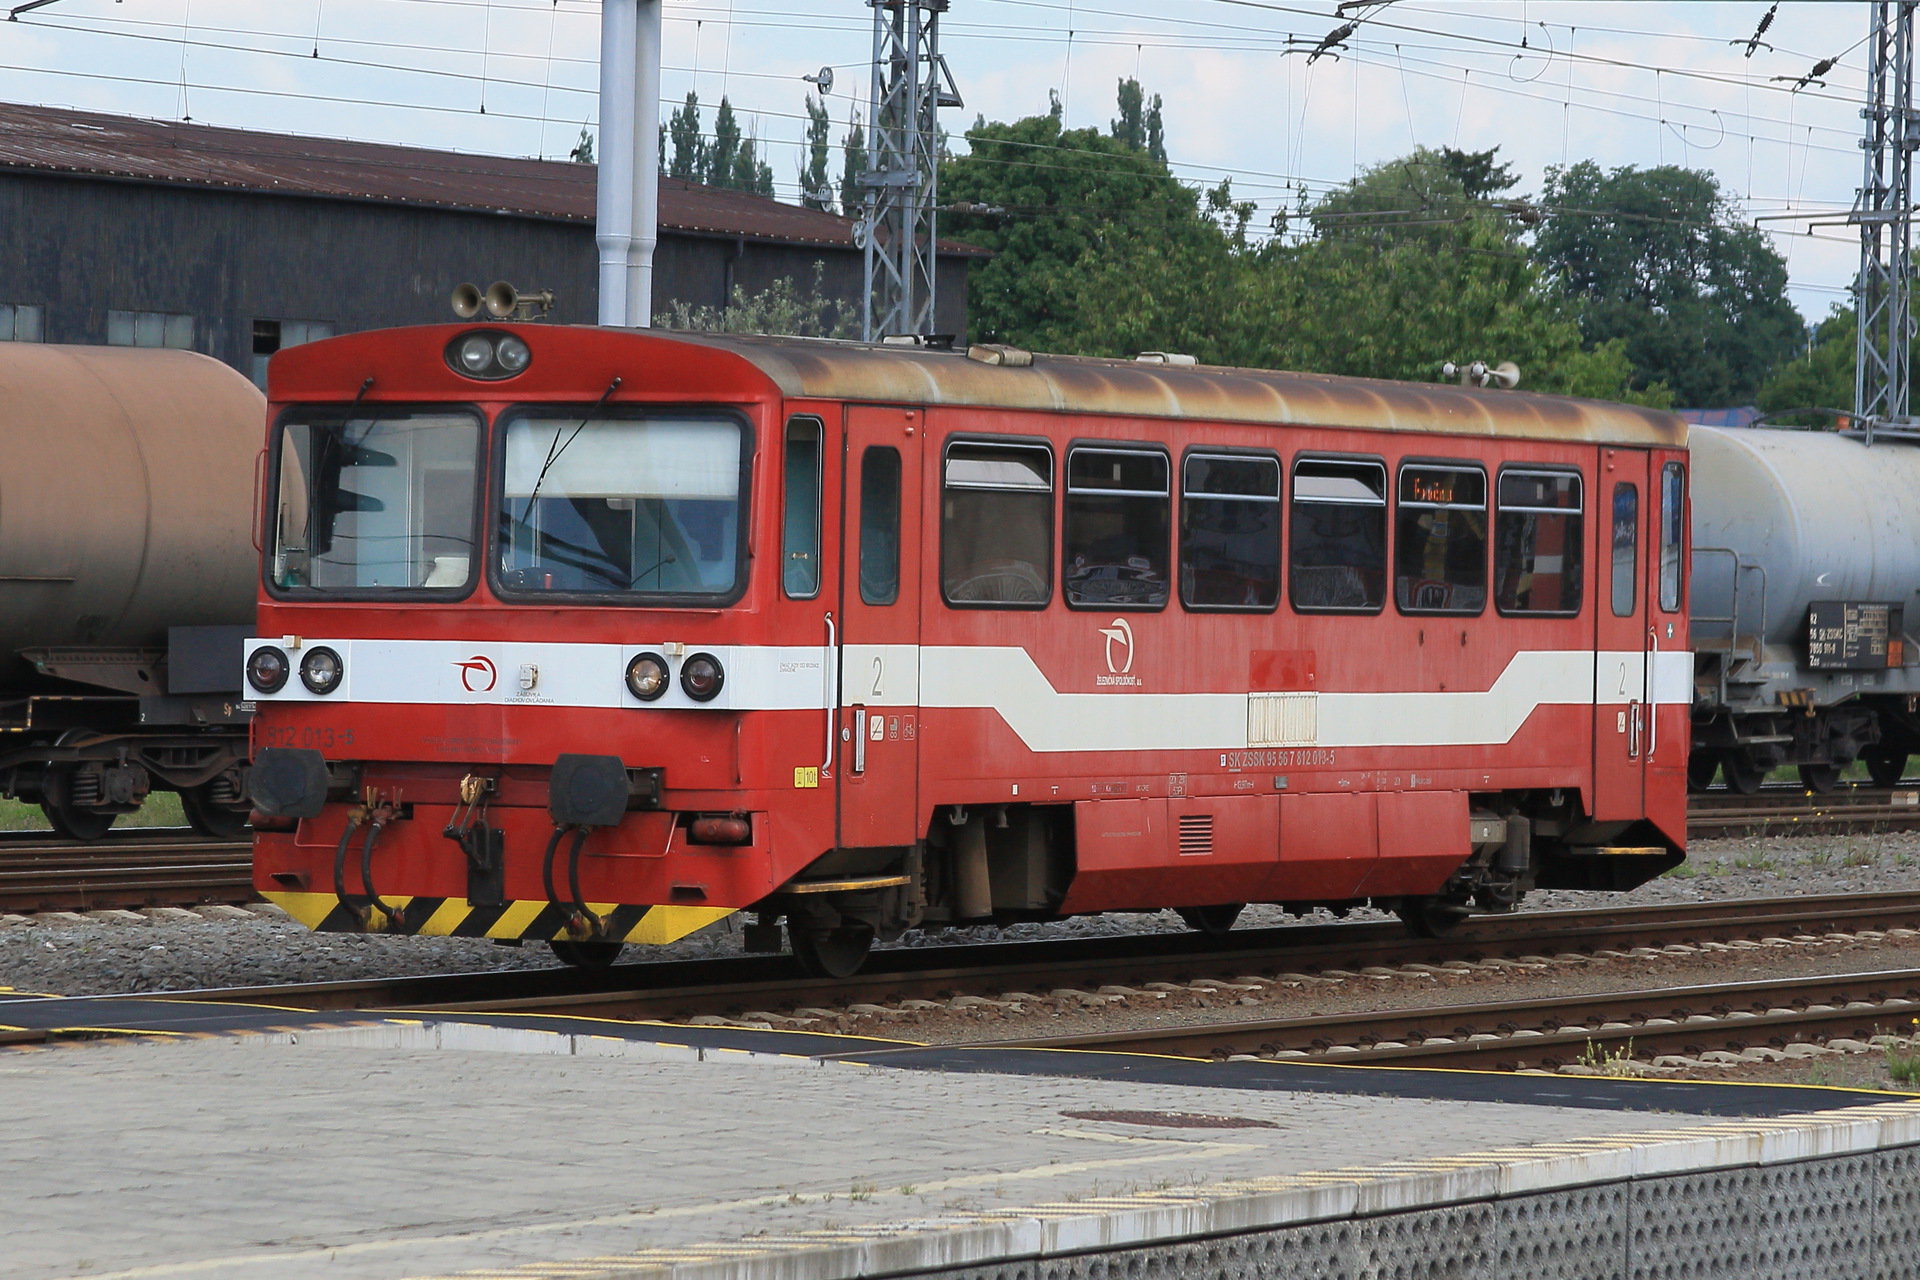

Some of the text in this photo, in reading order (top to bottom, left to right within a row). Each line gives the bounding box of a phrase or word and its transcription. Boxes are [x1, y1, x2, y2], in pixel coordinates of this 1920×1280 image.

[872, 656, 882, 696] 2
[1618, 662, 1626, 695] 2
[1228, 751, 1241, 768] SK
[1242, 751, 1265, 767] ZSSK
[1266, 751, 1277, 767] 95
[1278, 750, 1288, 766] 56
[1289, 750, 1295, 766] 7
[1296, 750, 1311, 766] 812
[806, 770, 817, 784] 10t
